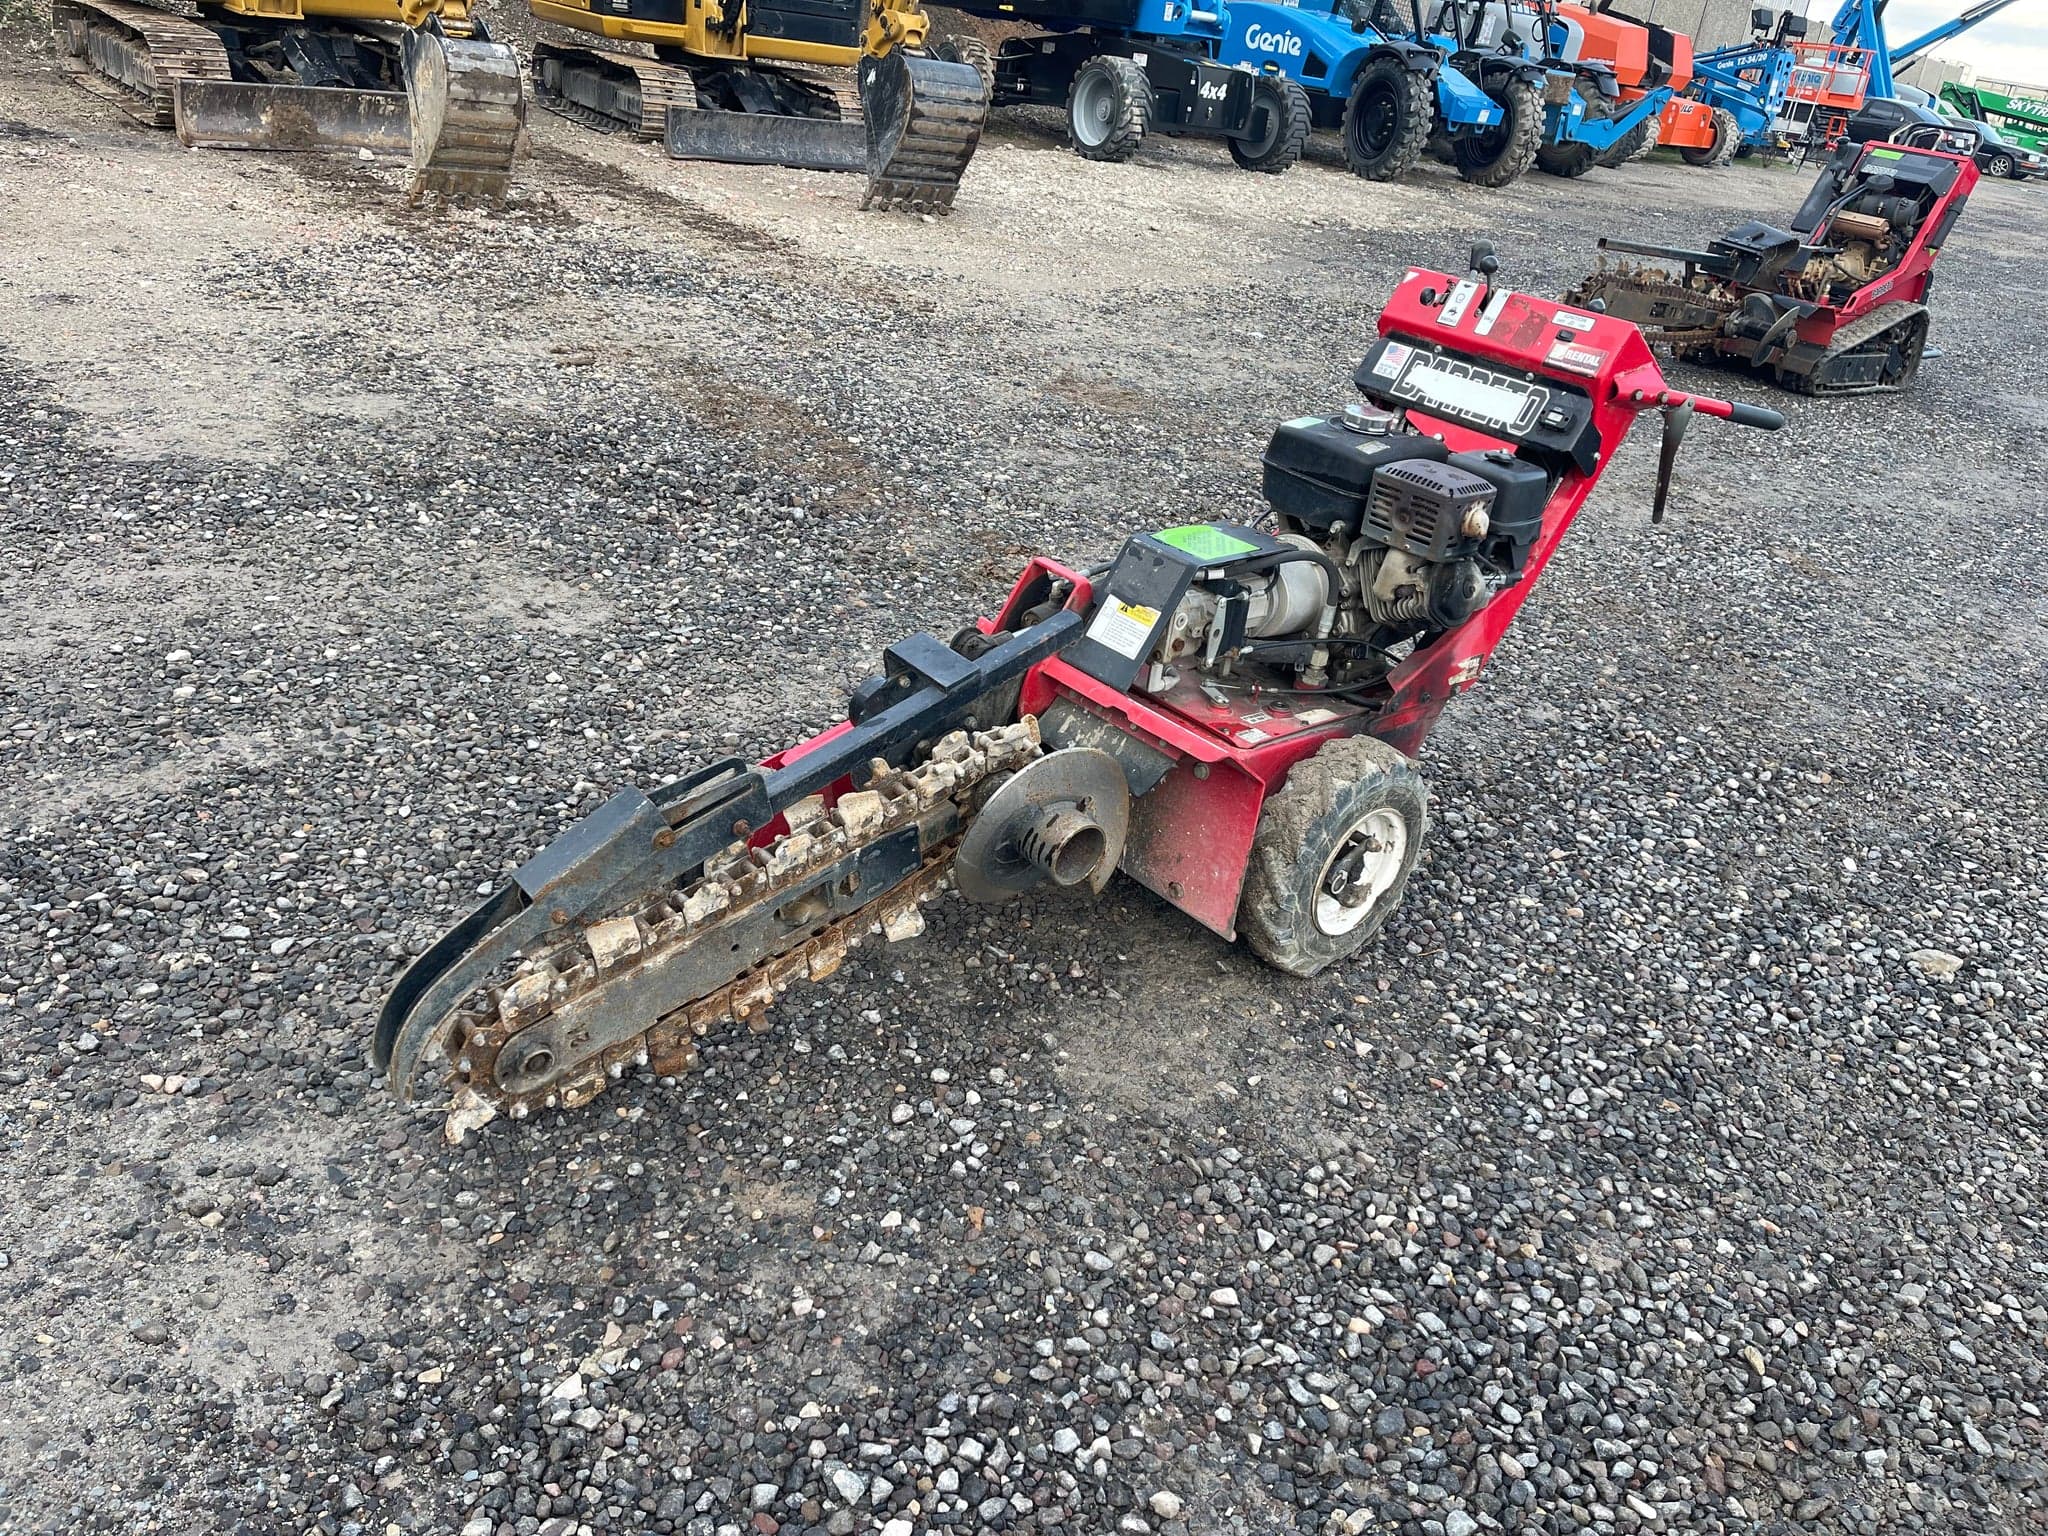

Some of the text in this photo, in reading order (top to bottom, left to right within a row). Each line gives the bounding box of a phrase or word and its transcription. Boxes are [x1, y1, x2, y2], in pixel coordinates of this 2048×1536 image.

[1245, 23, 1302, 56] Genie
[1200, 80, 1228, 100] 4x4
[1680, 104, 1693, 113] JLG
[1565, 349, 1601, 367] RENTAL
